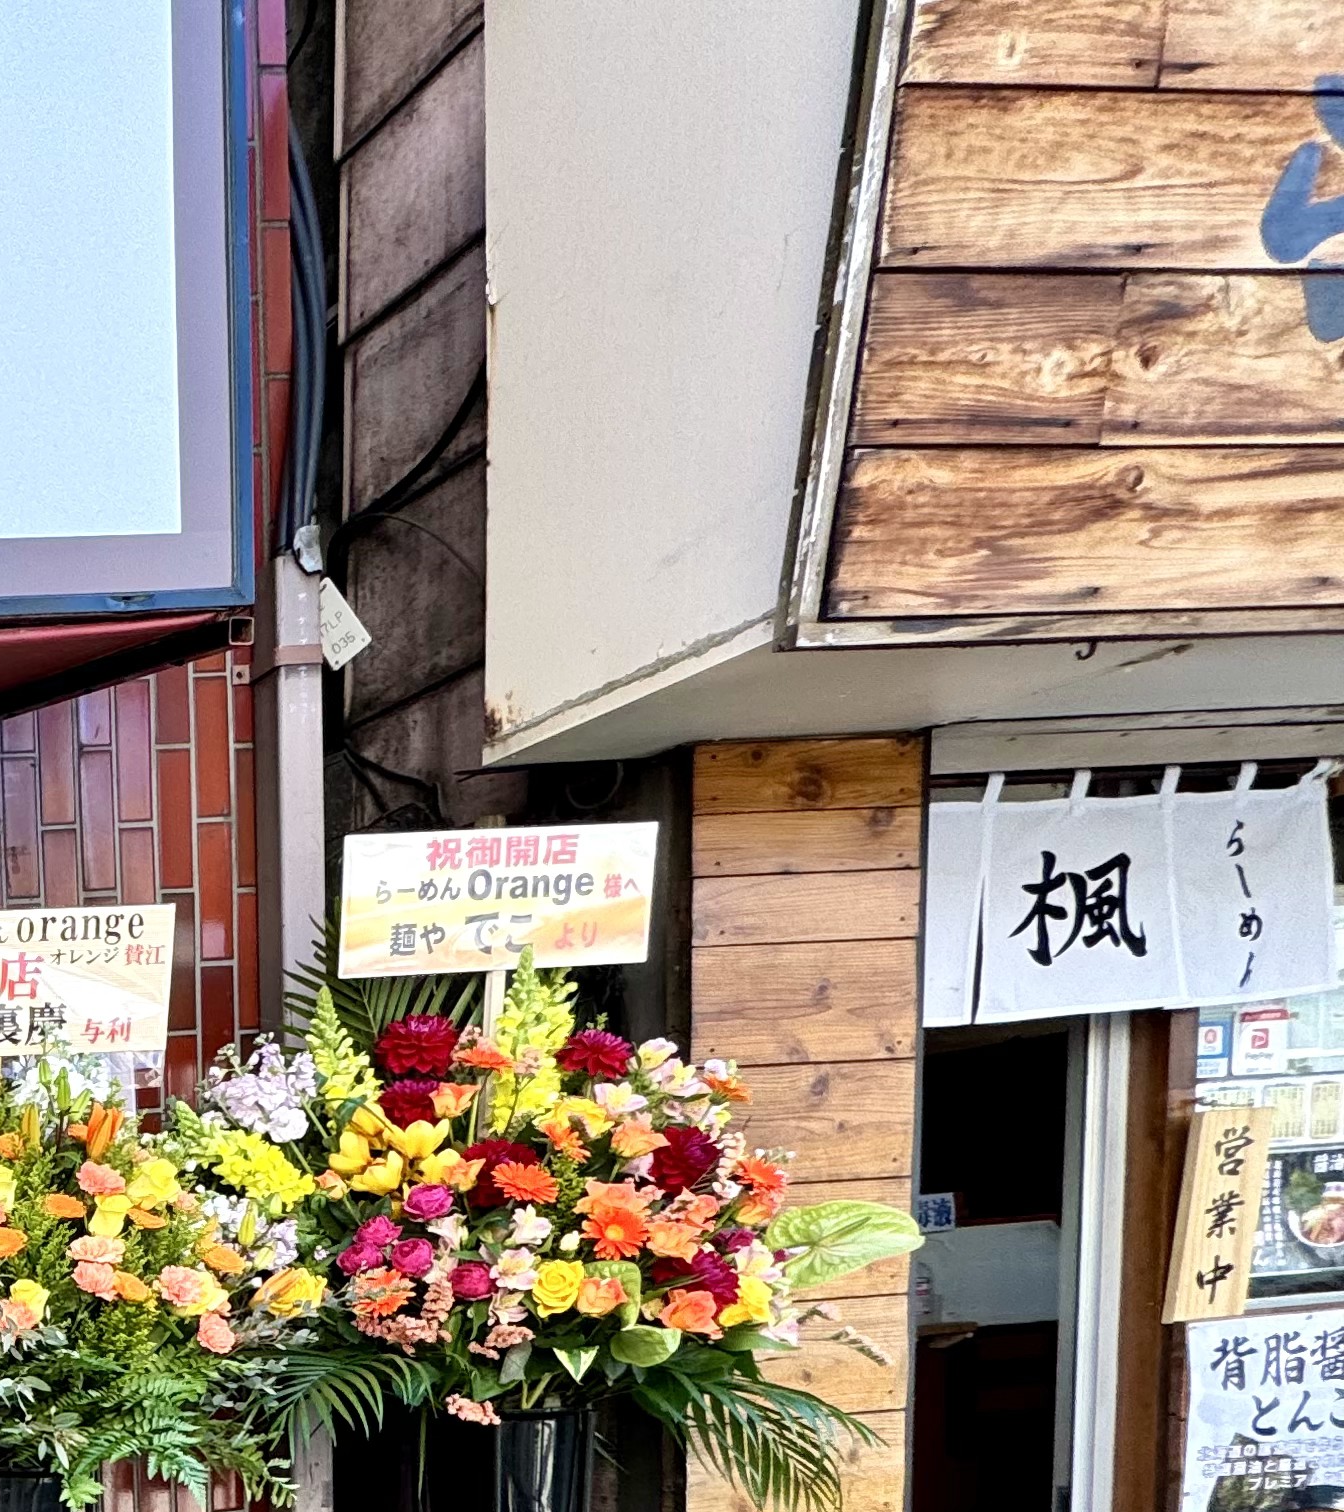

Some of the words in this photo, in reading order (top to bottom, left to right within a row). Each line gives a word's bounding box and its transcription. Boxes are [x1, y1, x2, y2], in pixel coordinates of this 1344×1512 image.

[332, 631, 356, 655] 035
[426, 833, 581, 871] 祝御開店
[1225, 819, 1264, 989] らーめん
[16, 911, 145, 946] orange
[1195, 1124, 1255, 1305] 営業中
